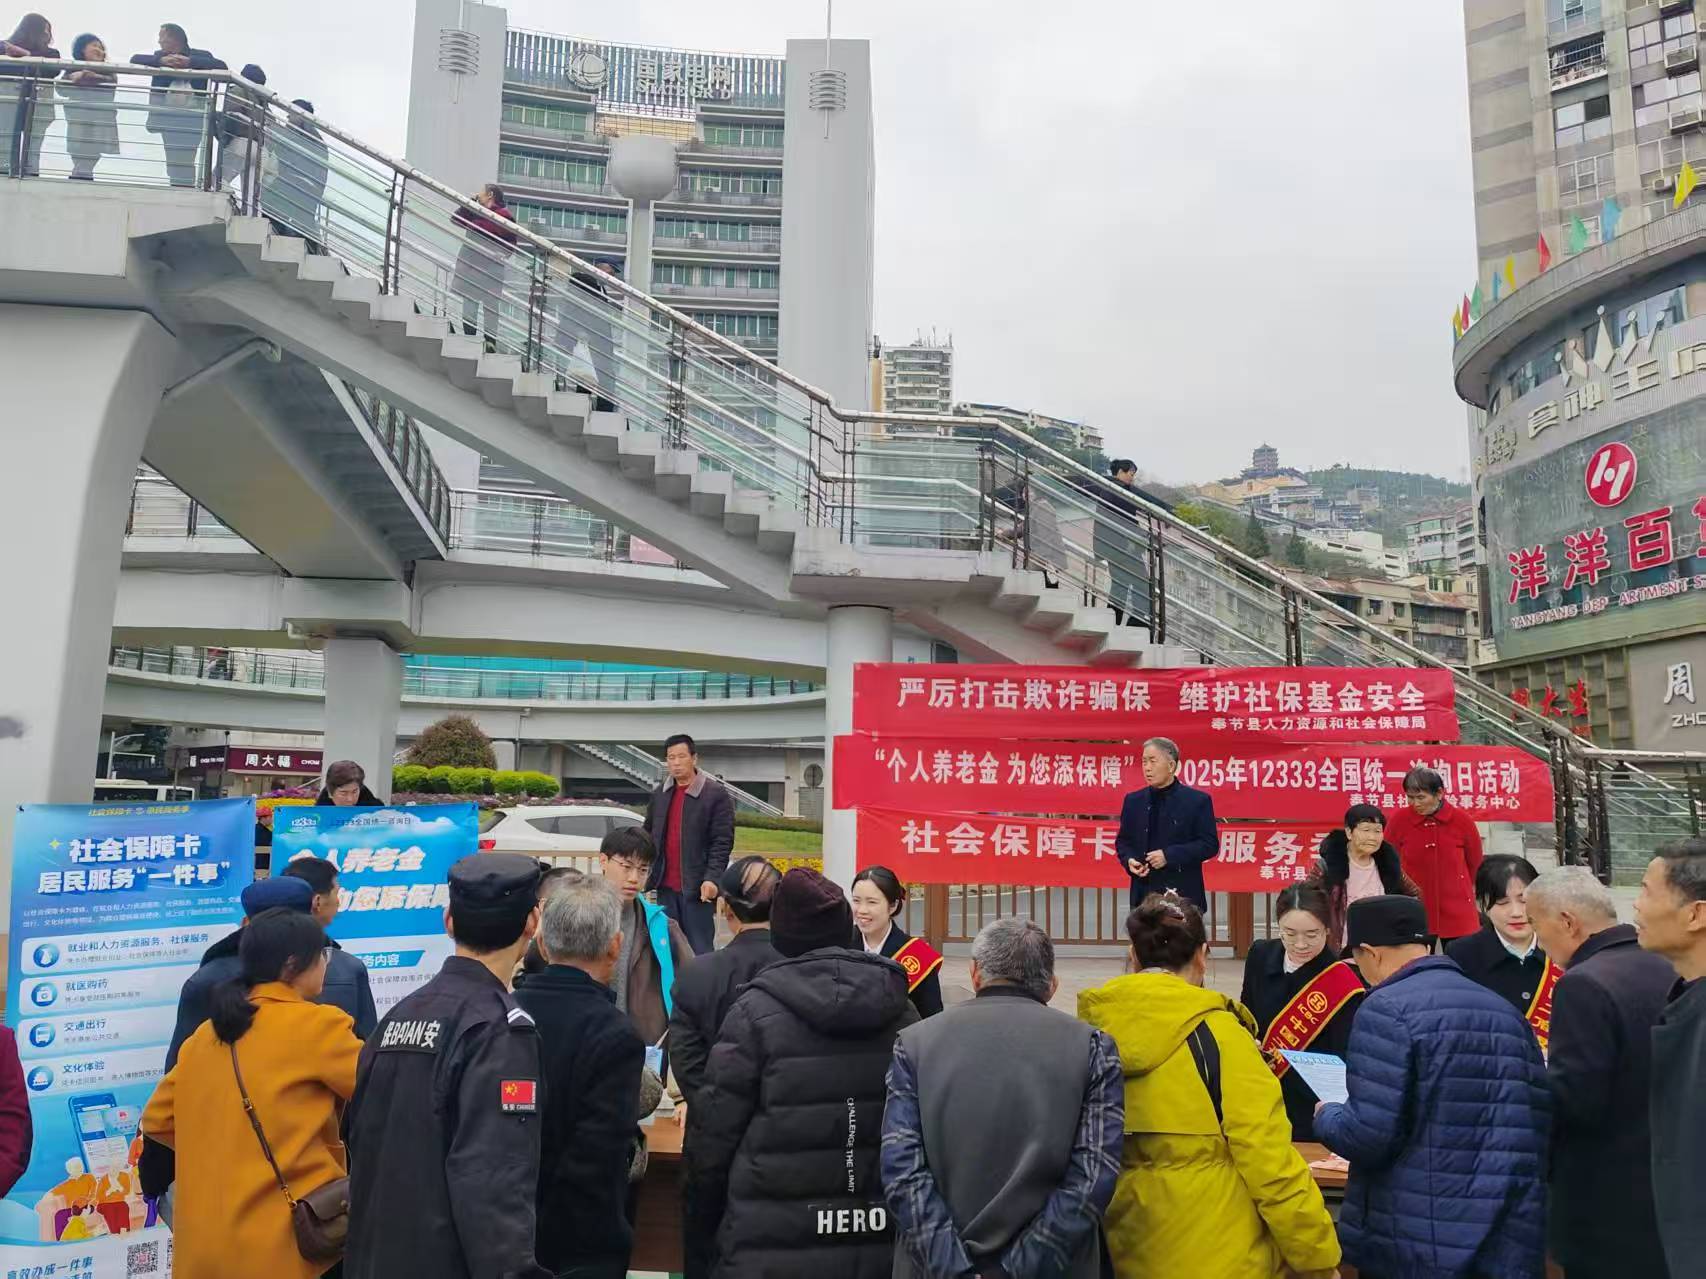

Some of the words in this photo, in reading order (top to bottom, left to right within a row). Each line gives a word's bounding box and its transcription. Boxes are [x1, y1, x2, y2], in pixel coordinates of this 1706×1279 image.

[636, 57, 731, 85] 国家电网
[636, 79, 686, 97] STATE
[690, 85, 731, 99] GRD
[1510, 603, 1578, 630] YANGYANG
[1663, 662, 1696, 705] 周
[898, 677, 1151, 711] 严厉打击欺诈骗保
[1179, 680, 1426, 713] 维护社保基金安全
[1211, 715, 1426, 732] 奉节县人力资源和社会保障局
[245, 753, 291, 768] 周大福
[69, 833, 202, 863] 社会保障卡
[358, 953, 400, 968] 务内容
[65, 978, 108, 992] 就医购药
[63, 1018, 107, 1032] 交通出行
[1297, 1003, 1320, 1025] ICBC
[63, 1060, 105, 1074] 文化体验
[846, 1097, 856, 1148] CHALLENGE
[846, 1150, 854, 1168] THE
[847, 1169, 855, 1193] LIMIT
[816, 1207, 887, 1234] HERO
